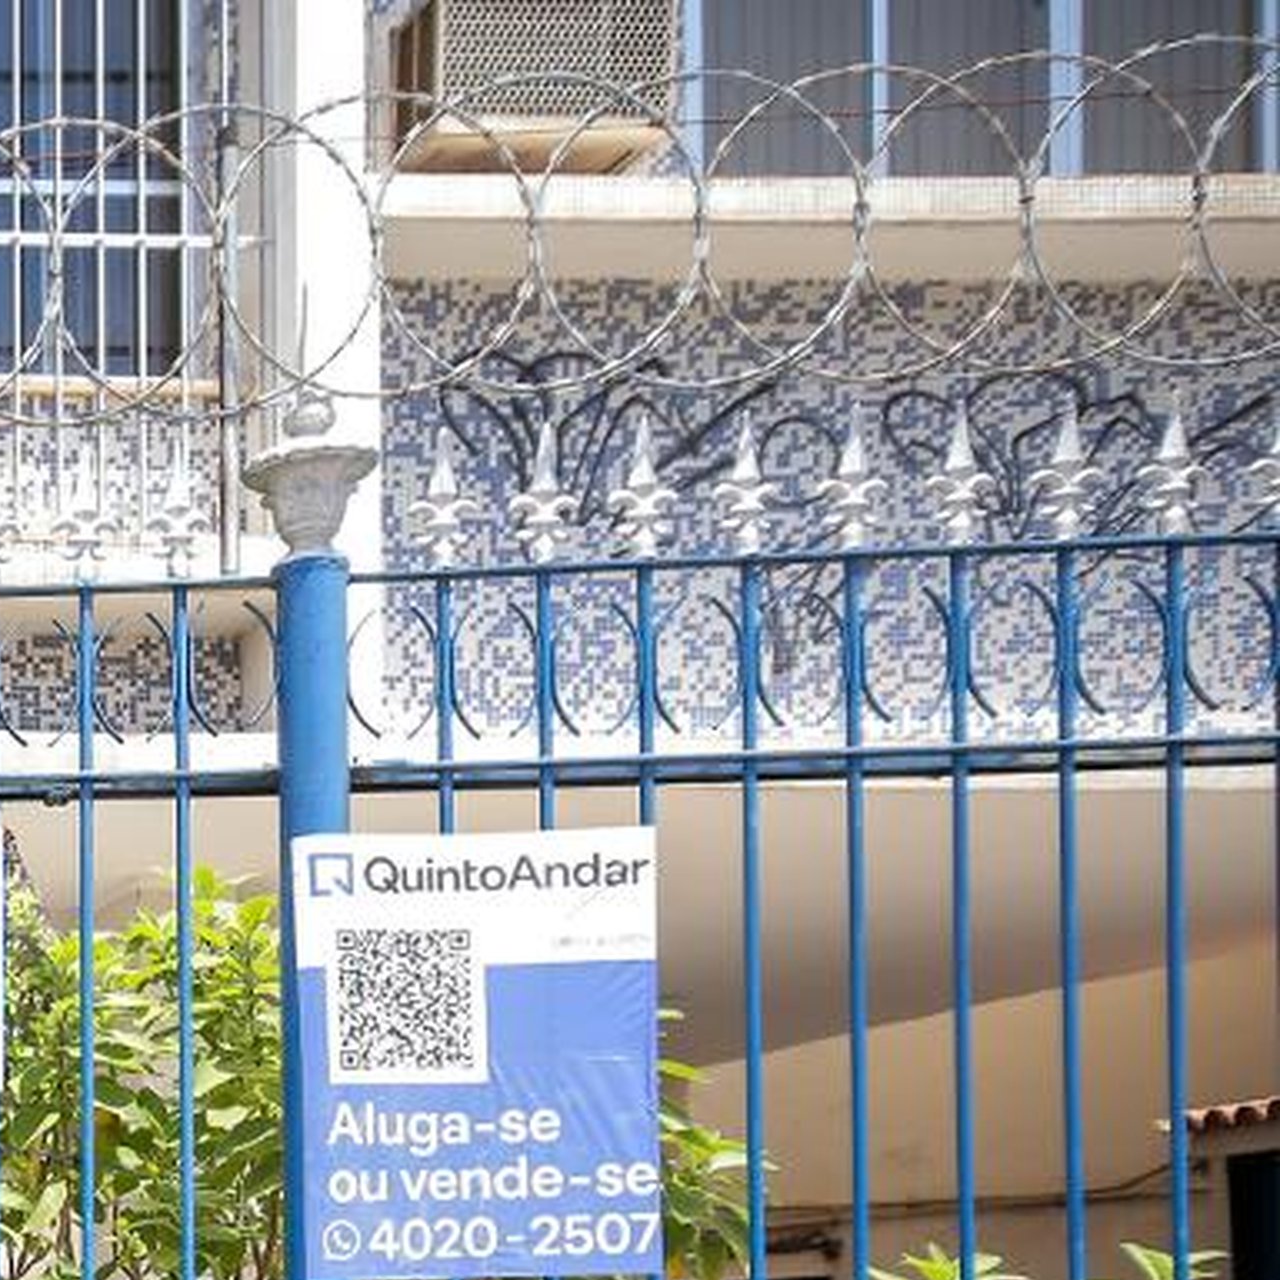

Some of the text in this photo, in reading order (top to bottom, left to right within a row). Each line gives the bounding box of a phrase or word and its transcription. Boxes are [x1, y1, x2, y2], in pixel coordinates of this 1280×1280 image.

[363, 853, 651, 894] QuintoAndar
[326, 1102, 561, 1157] Aluga-se
[328, 1157, 660, 1202] ou vende-se
[368, 1212, 661, 1261] 4020-2507
